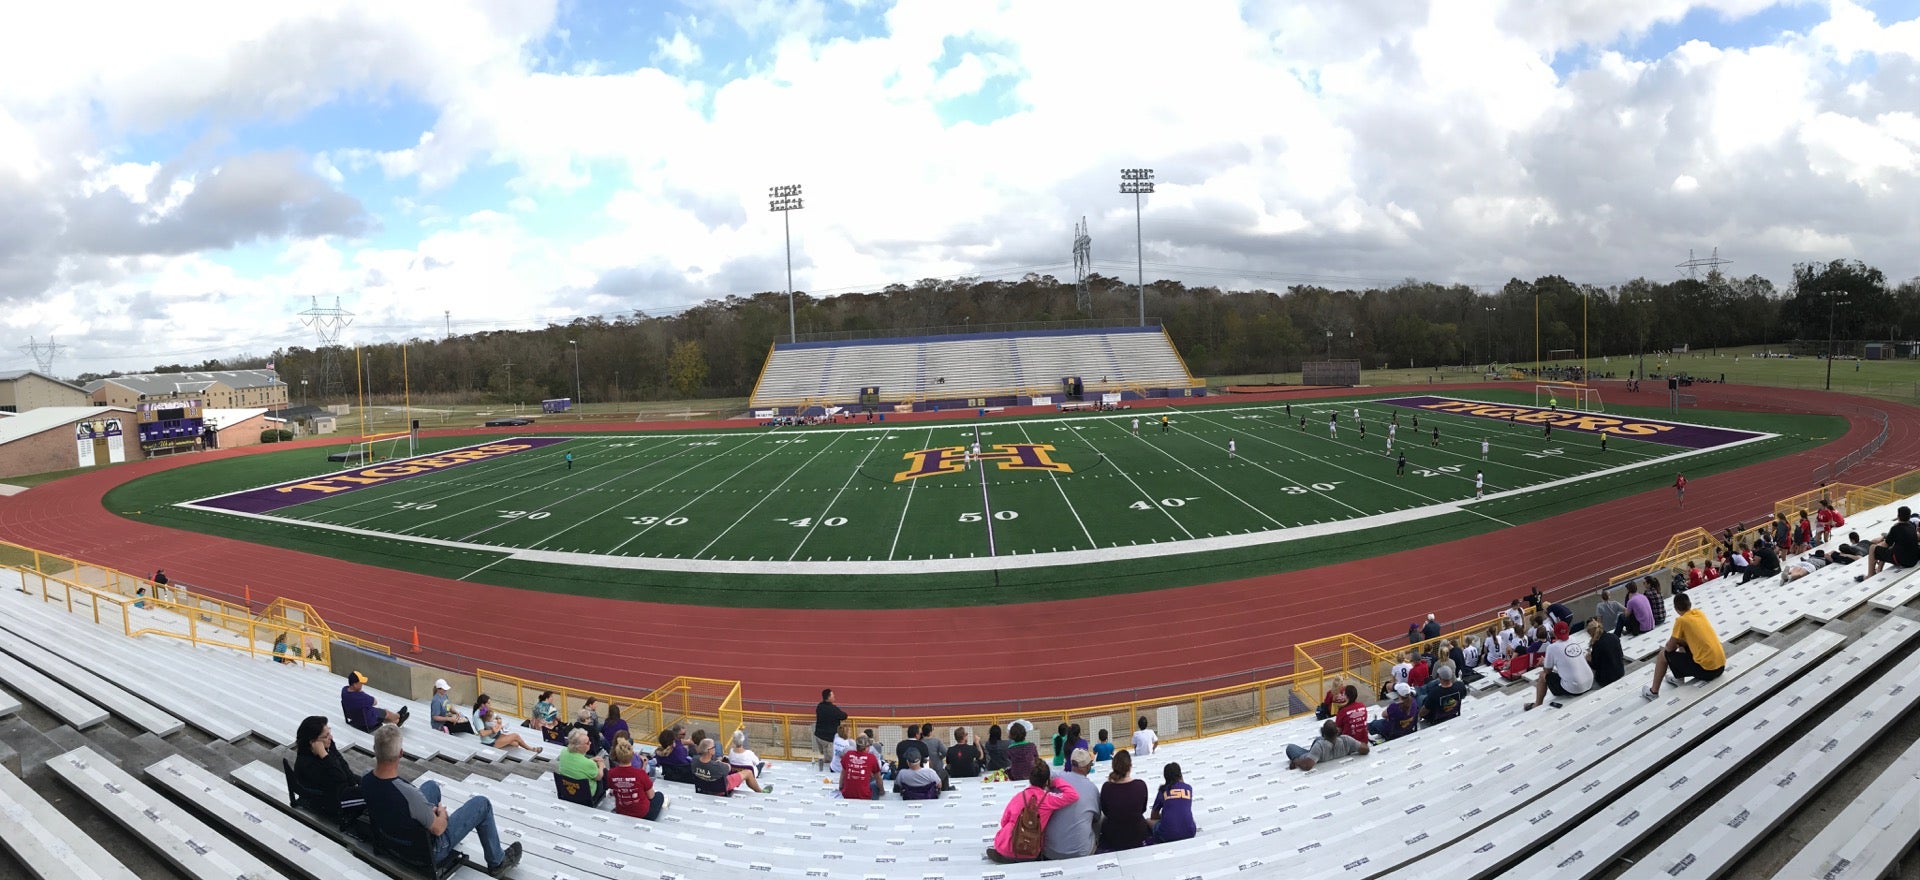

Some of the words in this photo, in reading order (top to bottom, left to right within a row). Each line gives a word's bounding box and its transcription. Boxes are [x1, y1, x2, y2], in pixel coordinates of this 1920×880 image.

[1421, 401, 1676, 435] TIGERS
[1521, 449, 1564, 459] 10
[276, 444, 532, 493] TIGERS
[893, 443, 1074, 482] H
[1411, 466, 1461, 478] 20
[1280, 481, 1336, 495] 30
[1129, 498, 1186, 510] 40
[497, 510, 551, 520] 20
[632, 516, 689, 526] 30
[958, 510, 1019, 523] 50
[788, 517, 849, 527] 40
[1401, 667, 1407, 678] 8
[1163, 788, 1191, 800] LSU
